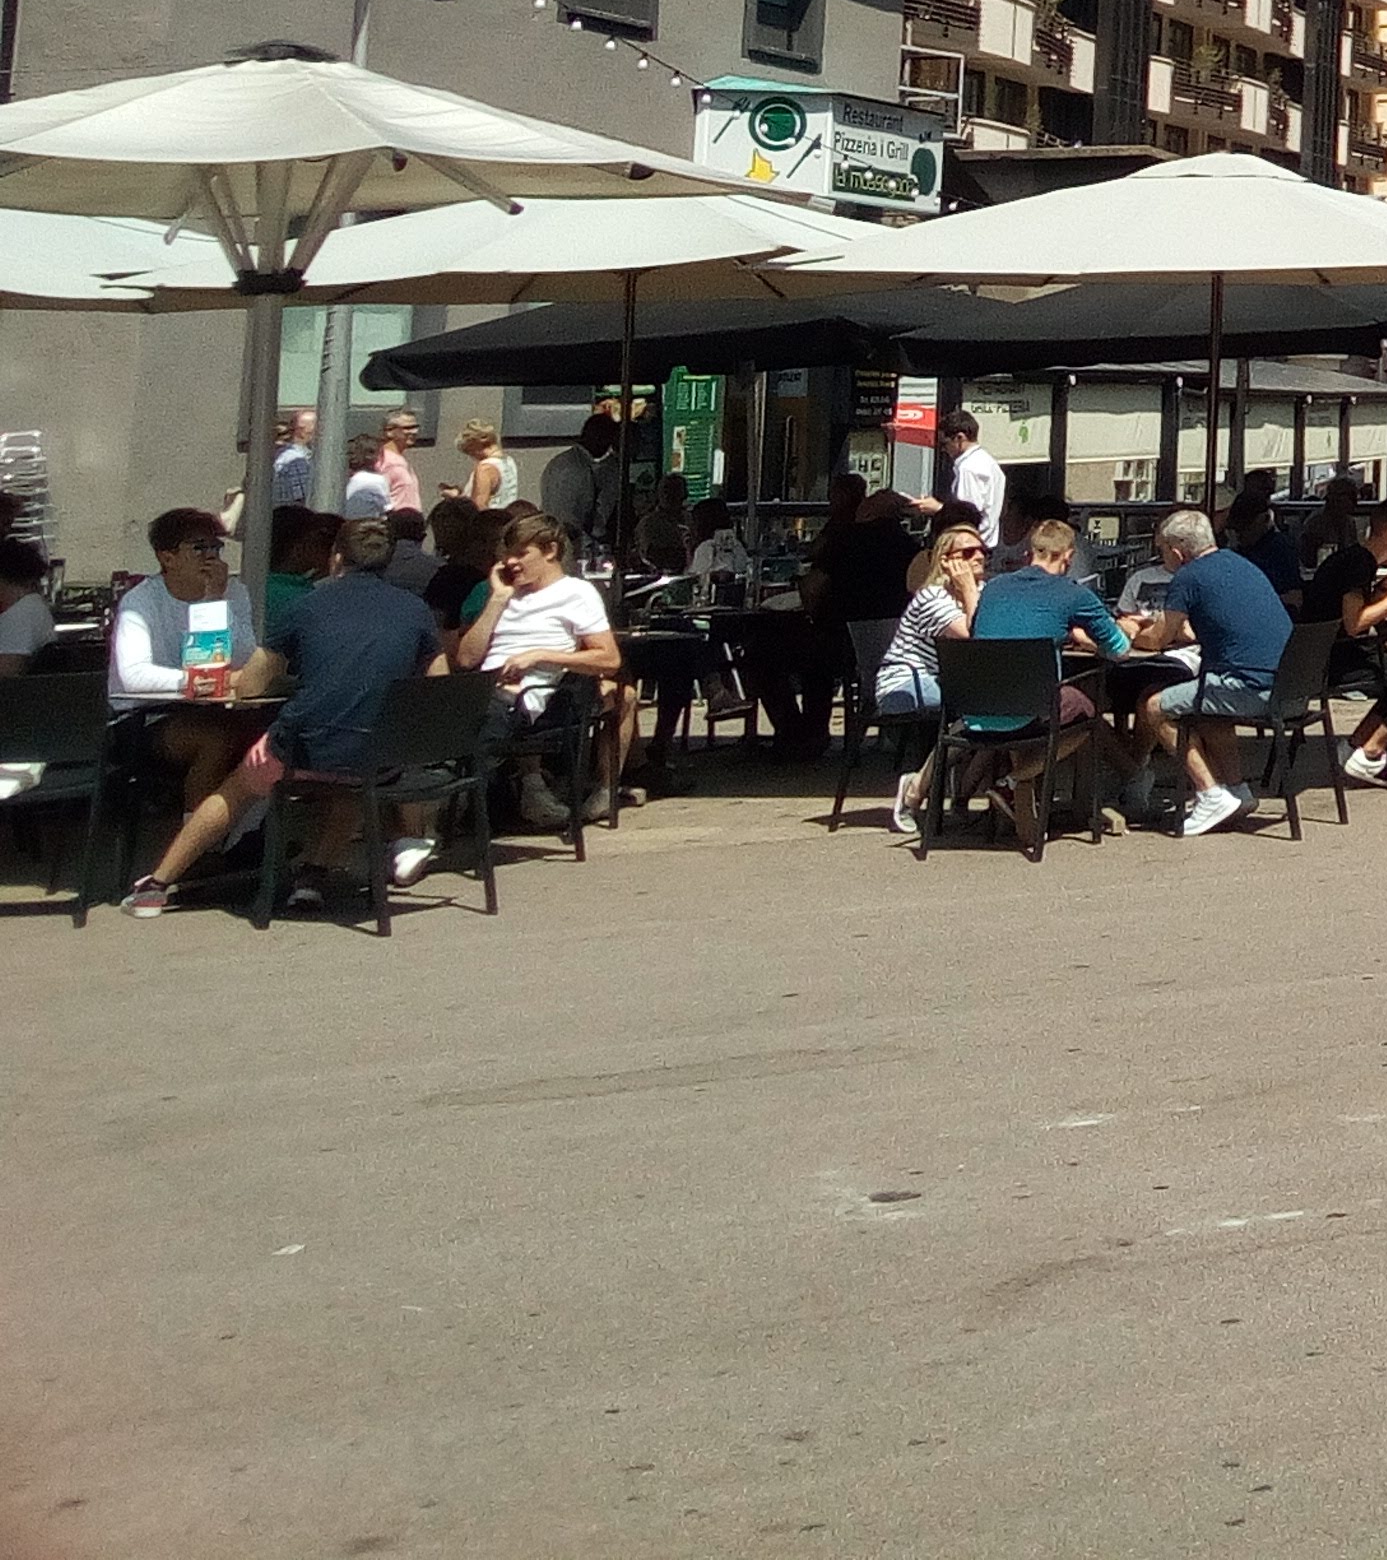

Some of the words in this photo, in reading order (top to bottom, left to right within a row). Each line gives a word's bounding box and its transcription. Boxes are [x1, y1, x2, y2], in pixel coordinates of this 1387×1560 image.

[843, 103, 903, 133] Restaurant
[834, 130, 877, 156] Pizzeria
[887, 140, 909, 161] Grill
